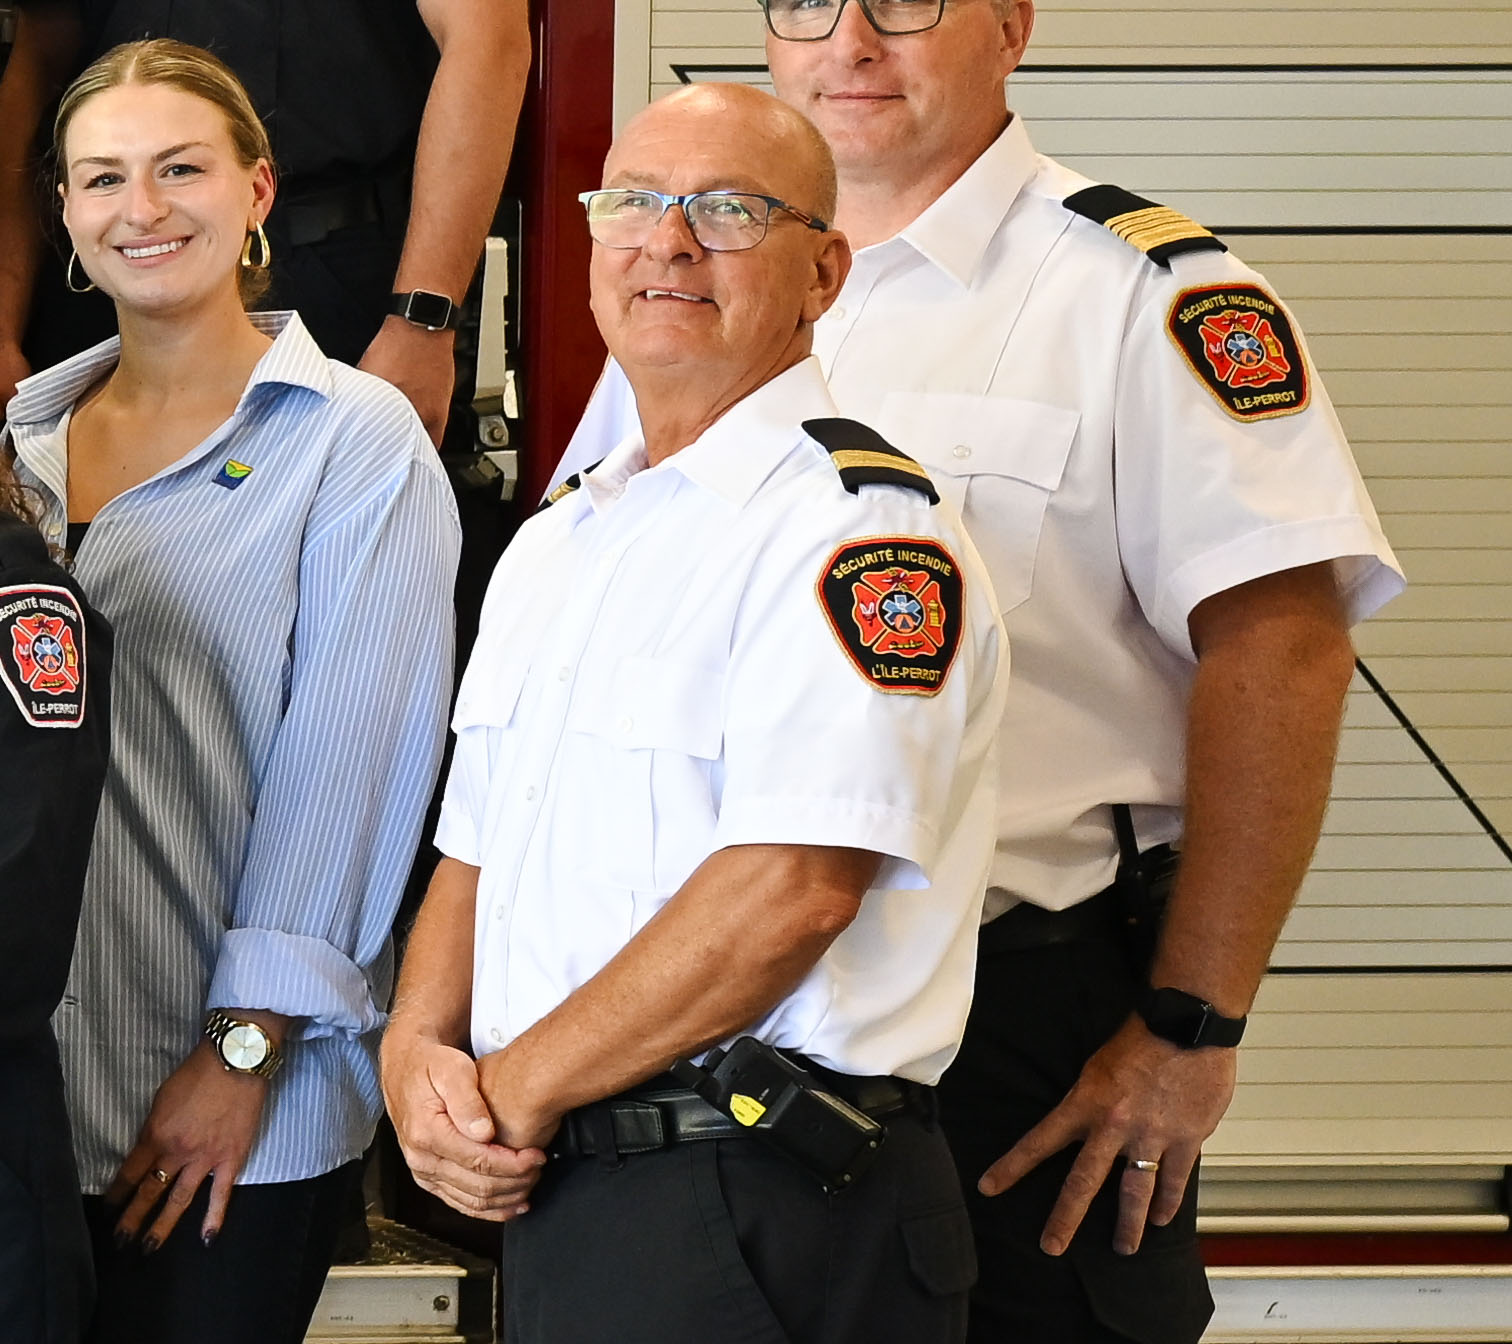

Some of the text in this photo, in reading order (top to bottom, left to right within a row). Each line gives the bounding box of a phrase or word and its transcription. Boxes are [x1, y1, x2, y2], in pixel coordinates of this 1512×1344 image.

[1179, 293, 1275, 324] SÉCURITÉ INCENDIE
[832, 548, 953, 580] SÉCURITÉ INCENDIE
